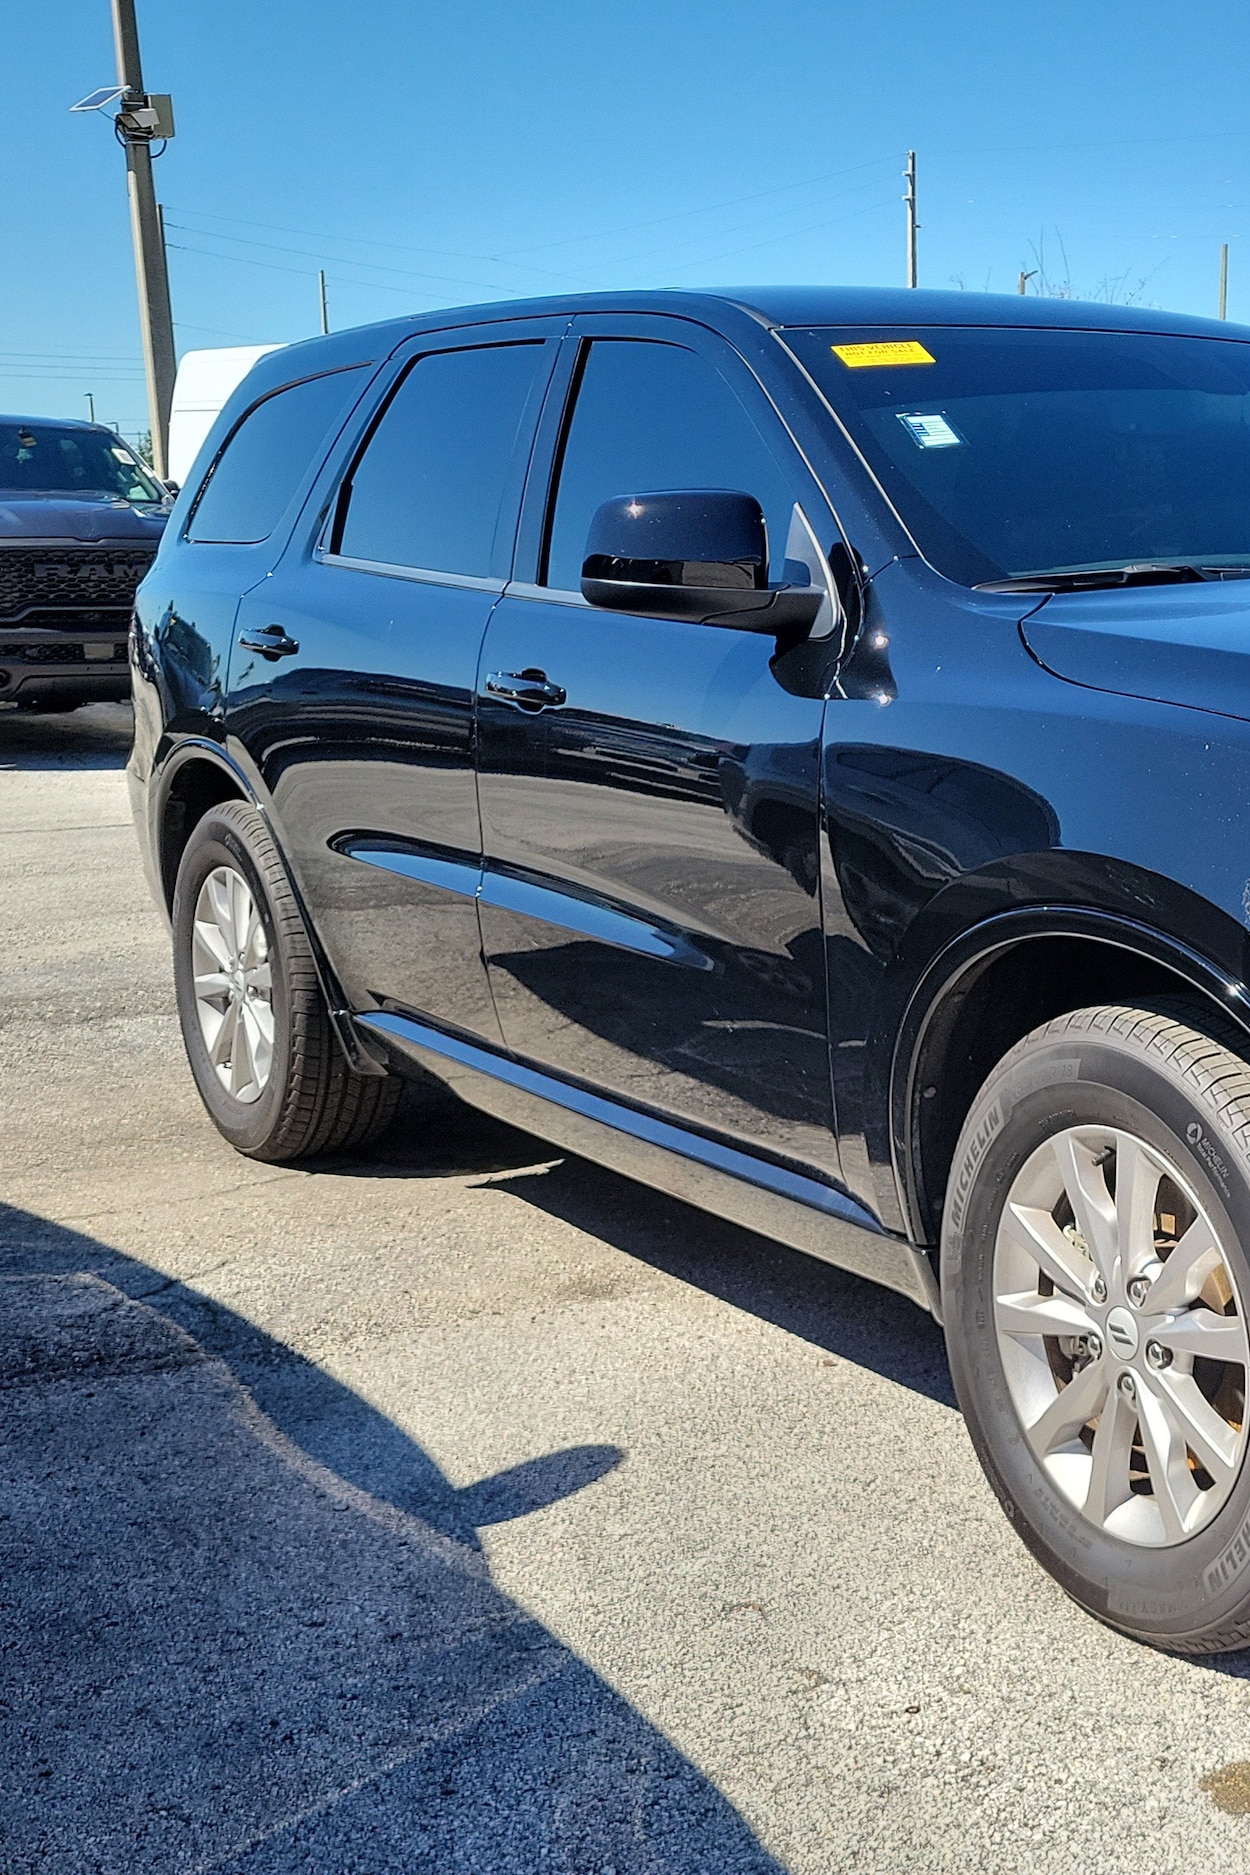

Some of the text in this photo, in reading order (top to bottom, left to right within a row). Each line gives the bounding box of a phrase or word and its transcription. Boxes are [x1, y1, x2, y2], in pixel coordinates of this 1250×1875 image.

[33, 563, 149, 578] RAM
[951, 1106, 1002, 1230] MICHELIN
[1201, 1137, 1230, 1178] MICHELIN
